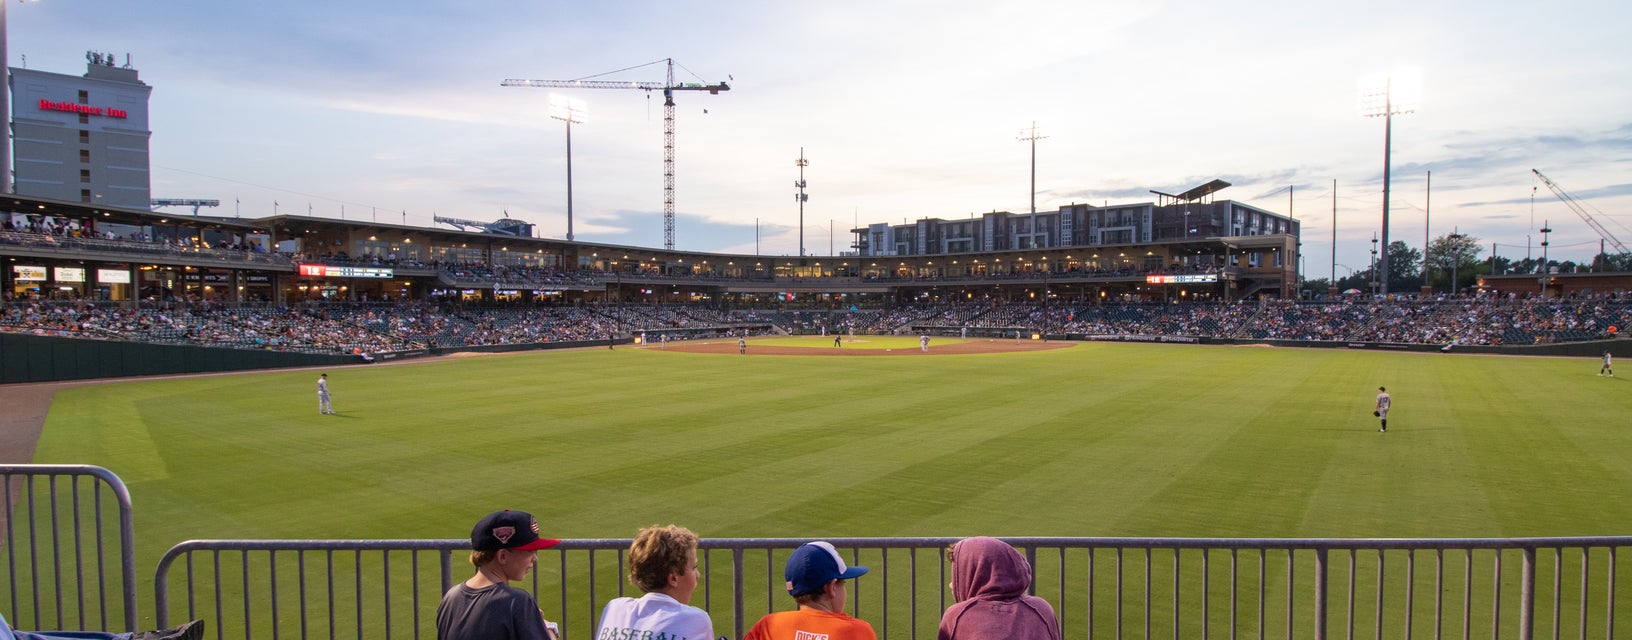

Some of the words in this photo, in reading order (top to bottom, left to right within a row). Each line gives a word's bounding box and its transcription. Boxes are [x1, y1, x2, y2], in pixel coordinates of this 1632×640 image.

[39, 98, 102, 115] Residence
[106, 107, 127, 118] Inn
[600, 627, 687, 640] BASEBA
